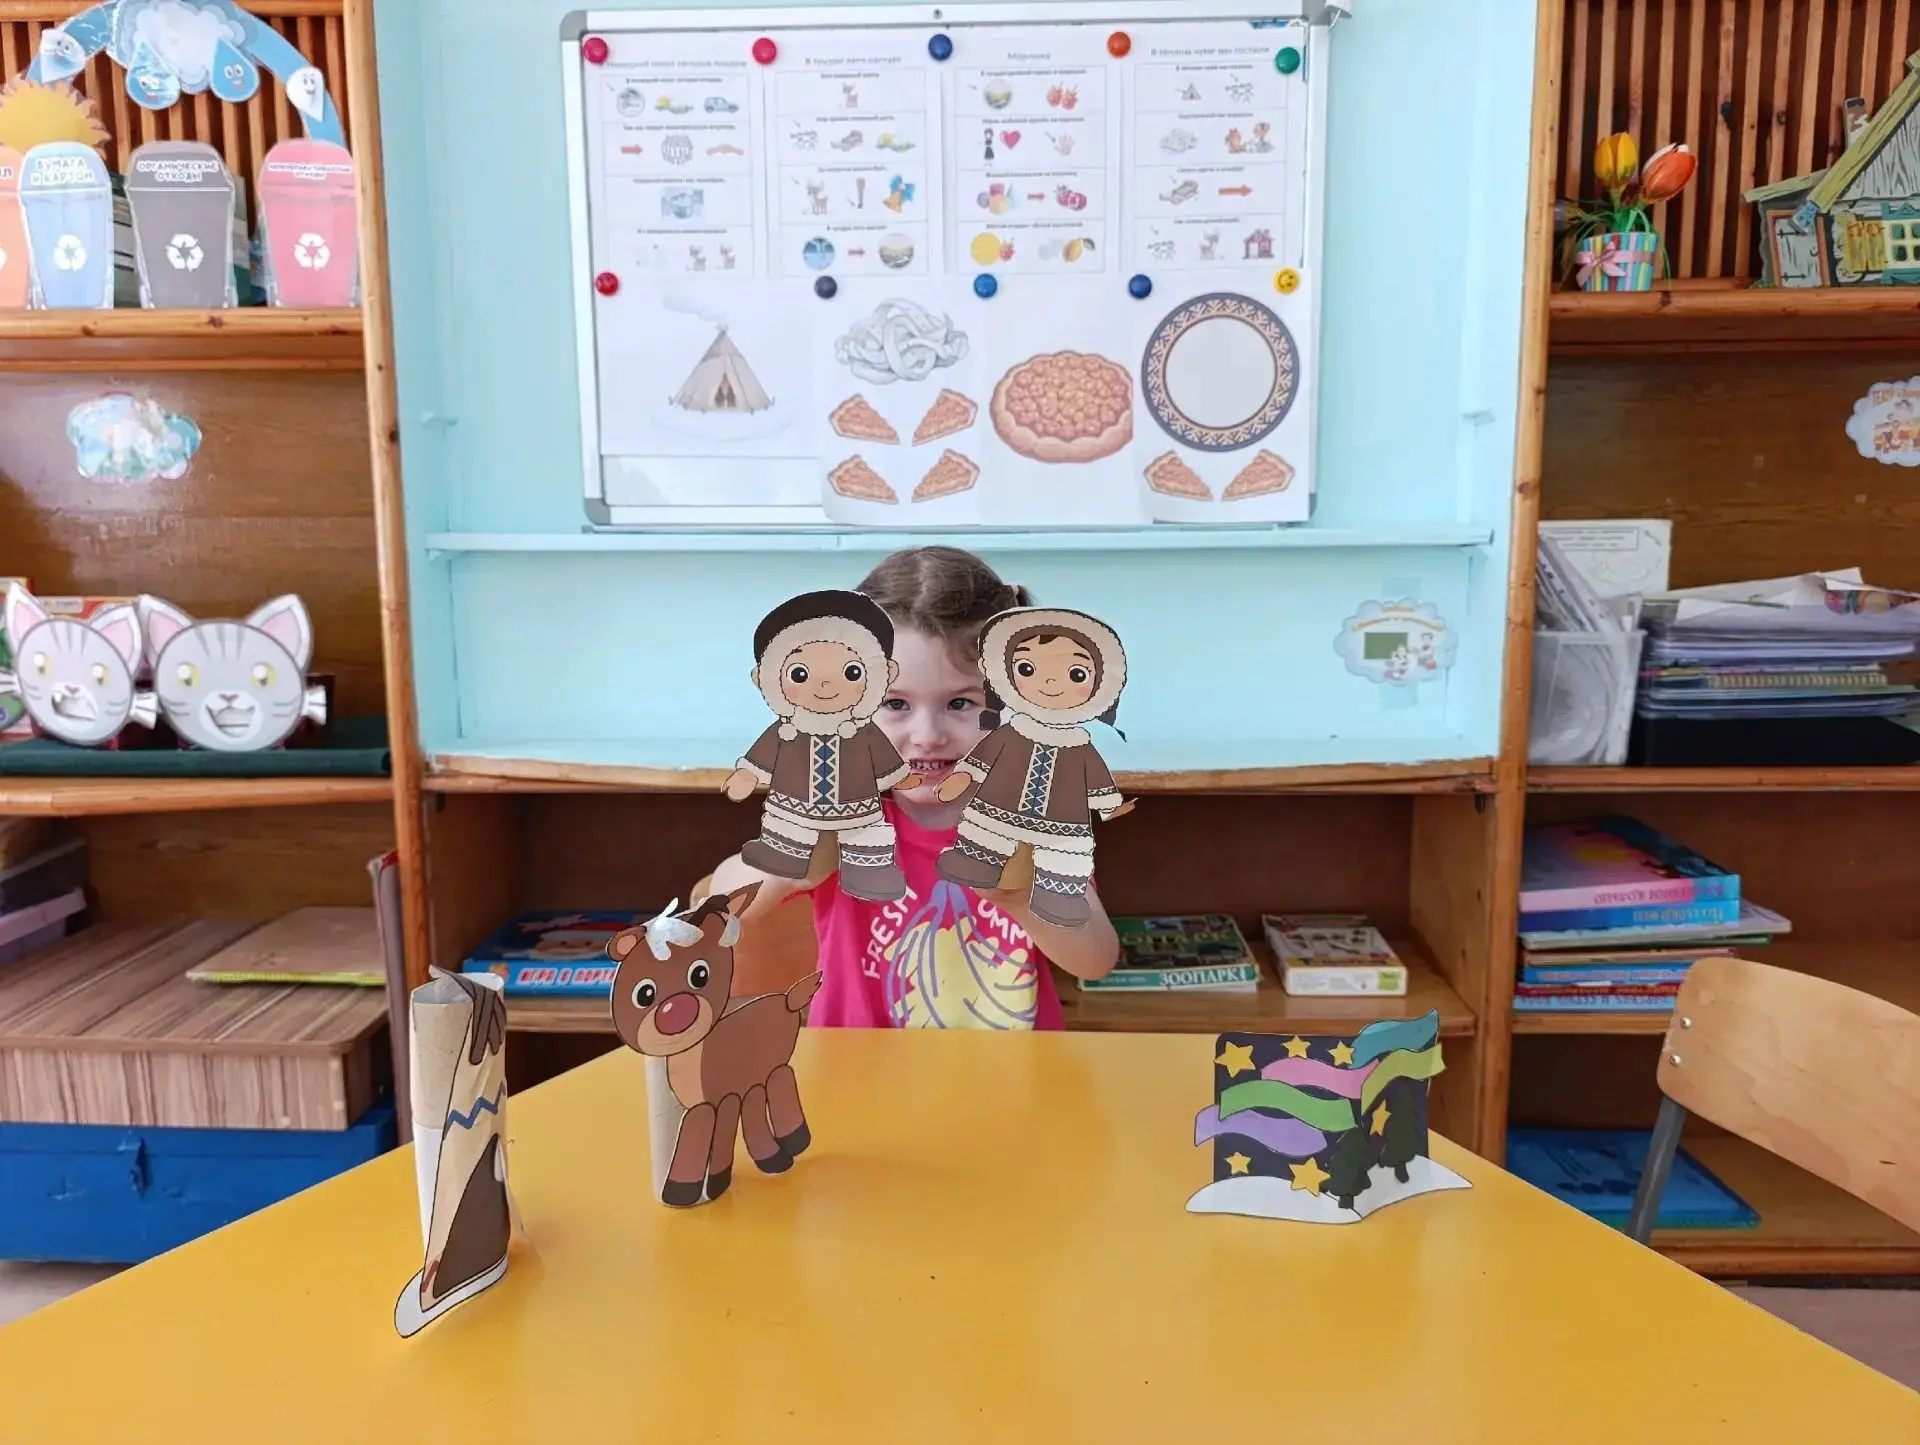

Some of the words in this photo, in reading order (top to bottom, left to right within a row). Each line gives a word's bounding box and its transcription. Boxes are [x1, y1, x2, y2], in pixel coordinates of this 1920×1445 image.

[37, 158, 86, 170] БУМАГА
[138, 160, 218, 171] ОРГАНИЧЕСКИЕ
[44, 171, 93, 182] КАРТОН
[157, 171, 202, 182] ОТХОДЫ
[861, 885, 918, 979] FRESH
